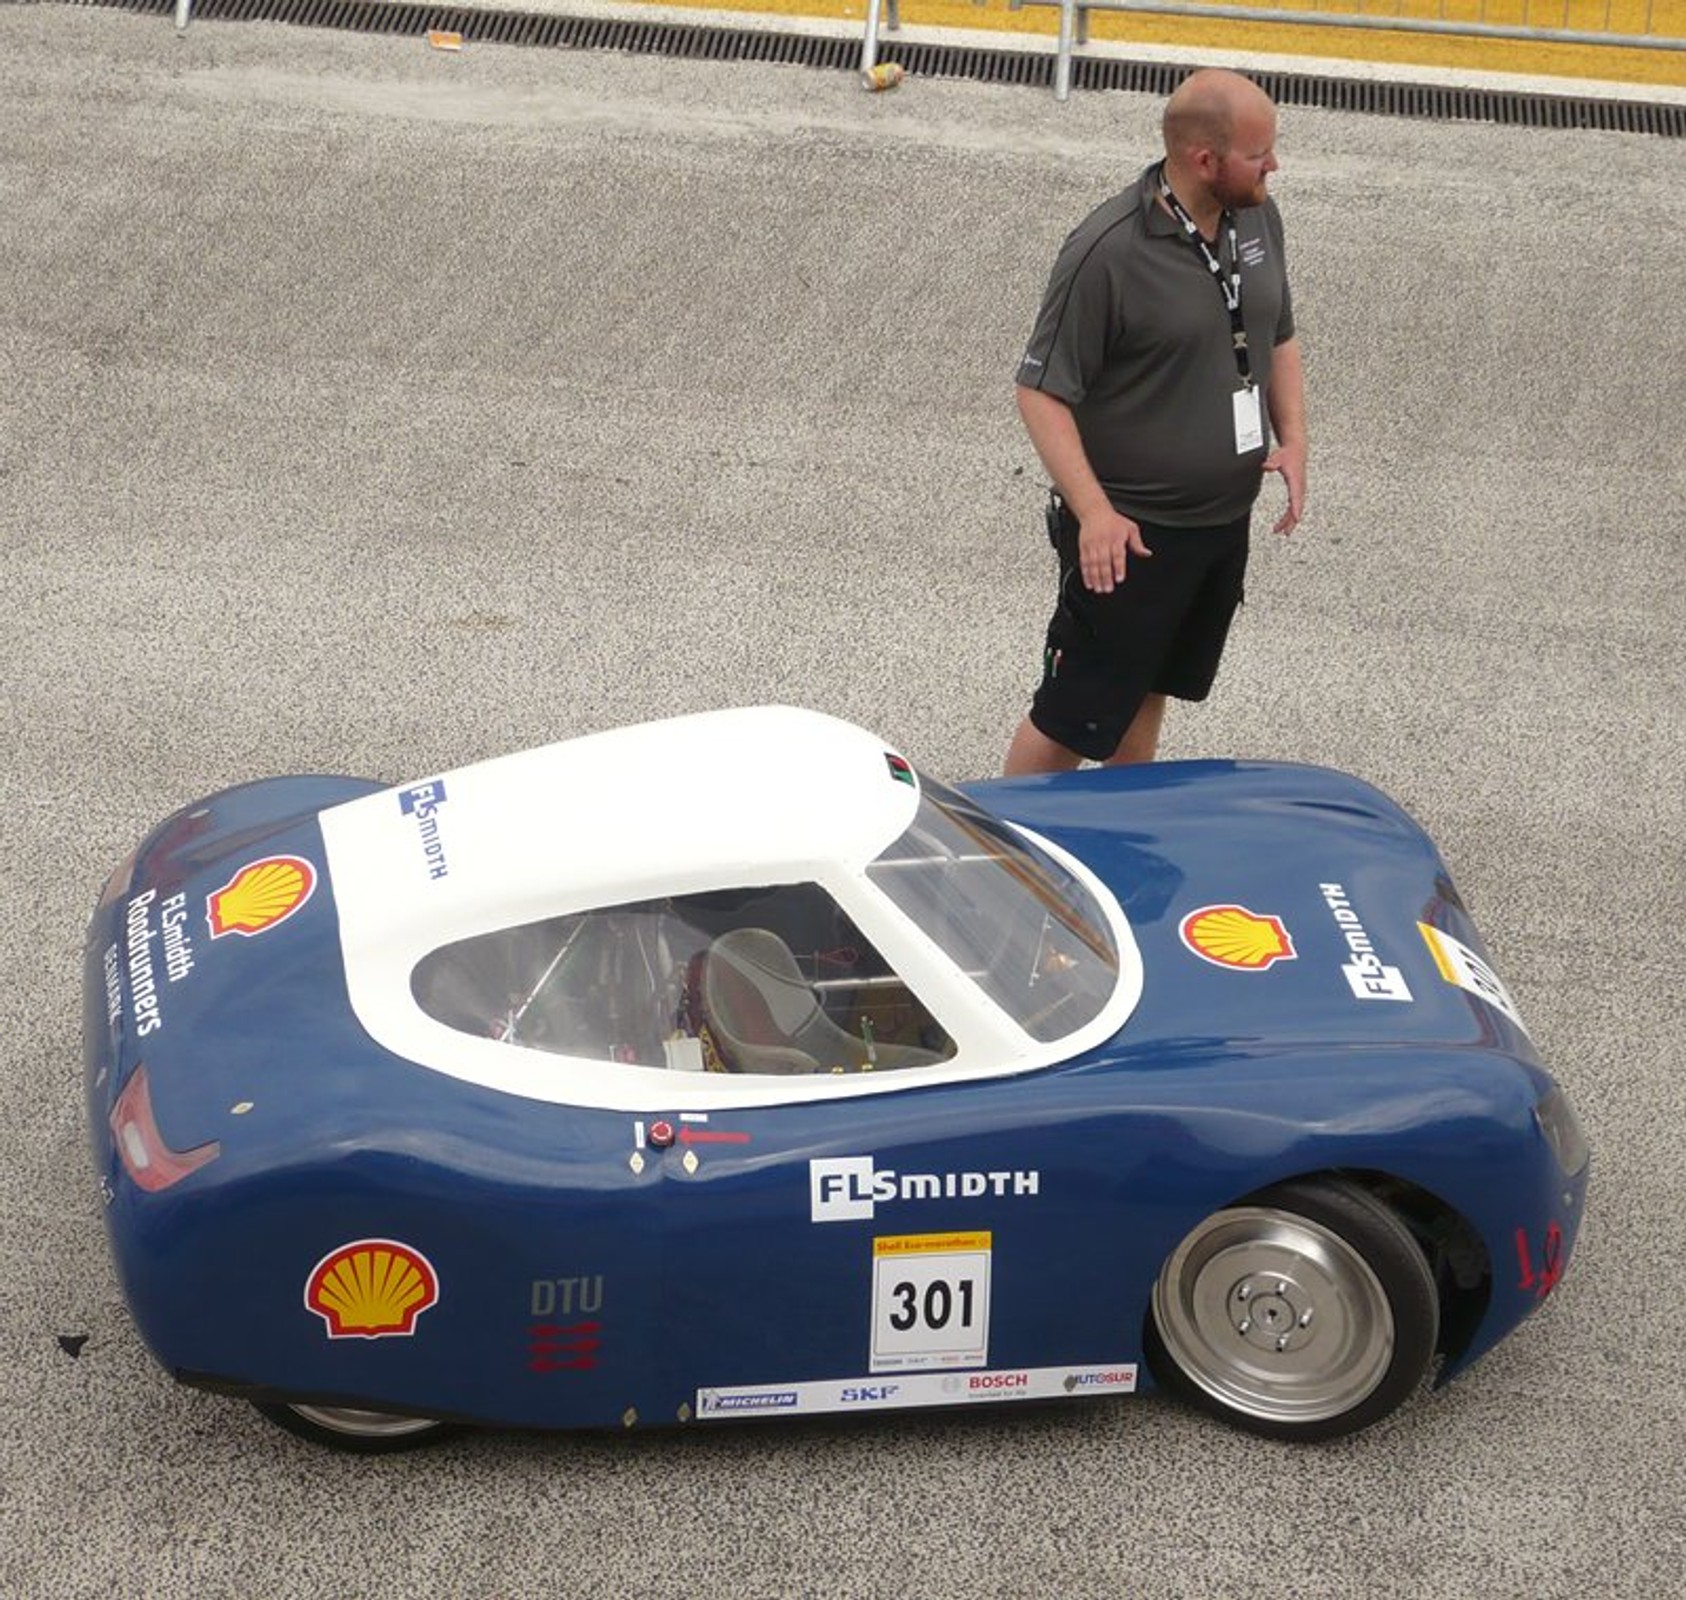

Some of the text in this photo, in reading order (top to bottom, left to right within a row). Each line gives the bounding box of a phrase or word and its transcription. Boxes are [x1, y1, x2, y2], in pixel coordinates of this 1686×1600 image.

[162, 892, 195, 982] FLSmidth
[127, 888, 162, 1037] Roadrunners
[877, 1242, 901, 1251] Shell
[531, 1275, 603, 1316] DTU
[889, 1279, 974, 1332] 301
[840, 1386, 899, 1402] SKF
[968, 1374, 1028, 1389] BOSCH
[719, 1395, 796, 1408] MICHELIN
